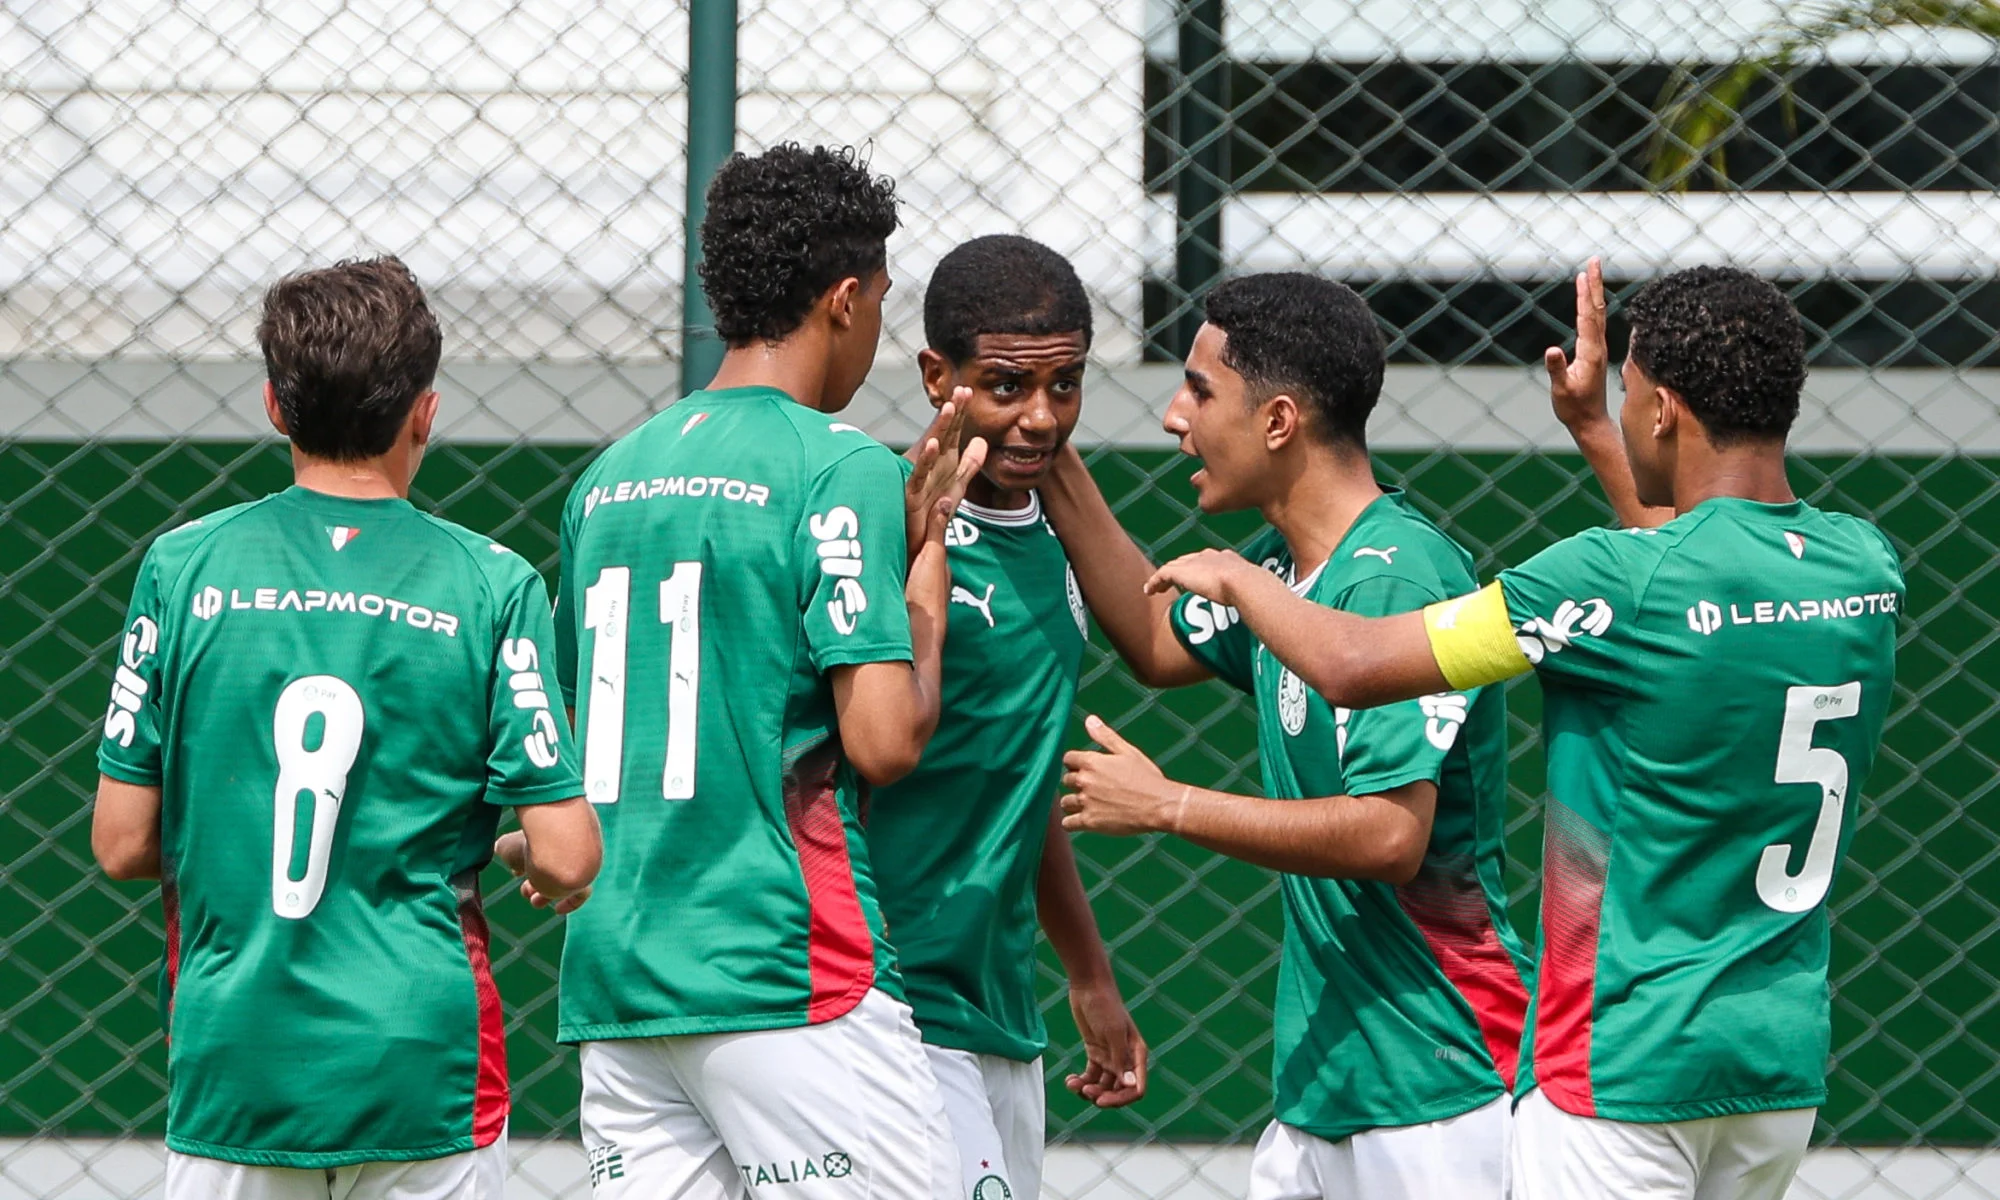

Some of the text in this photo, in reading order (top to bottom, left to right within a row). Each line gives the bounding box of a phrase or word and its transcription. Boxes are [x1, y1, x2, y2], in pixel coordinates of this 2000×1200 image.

[599, 476, 770, 507] LEAPMOTOR
[229, 586, 460, 638] LEAPMOTOR
[584, 560, 703, 805] 11
[272, 674, 367, 921] 8
[1755, 680, 1862, 914] 5
